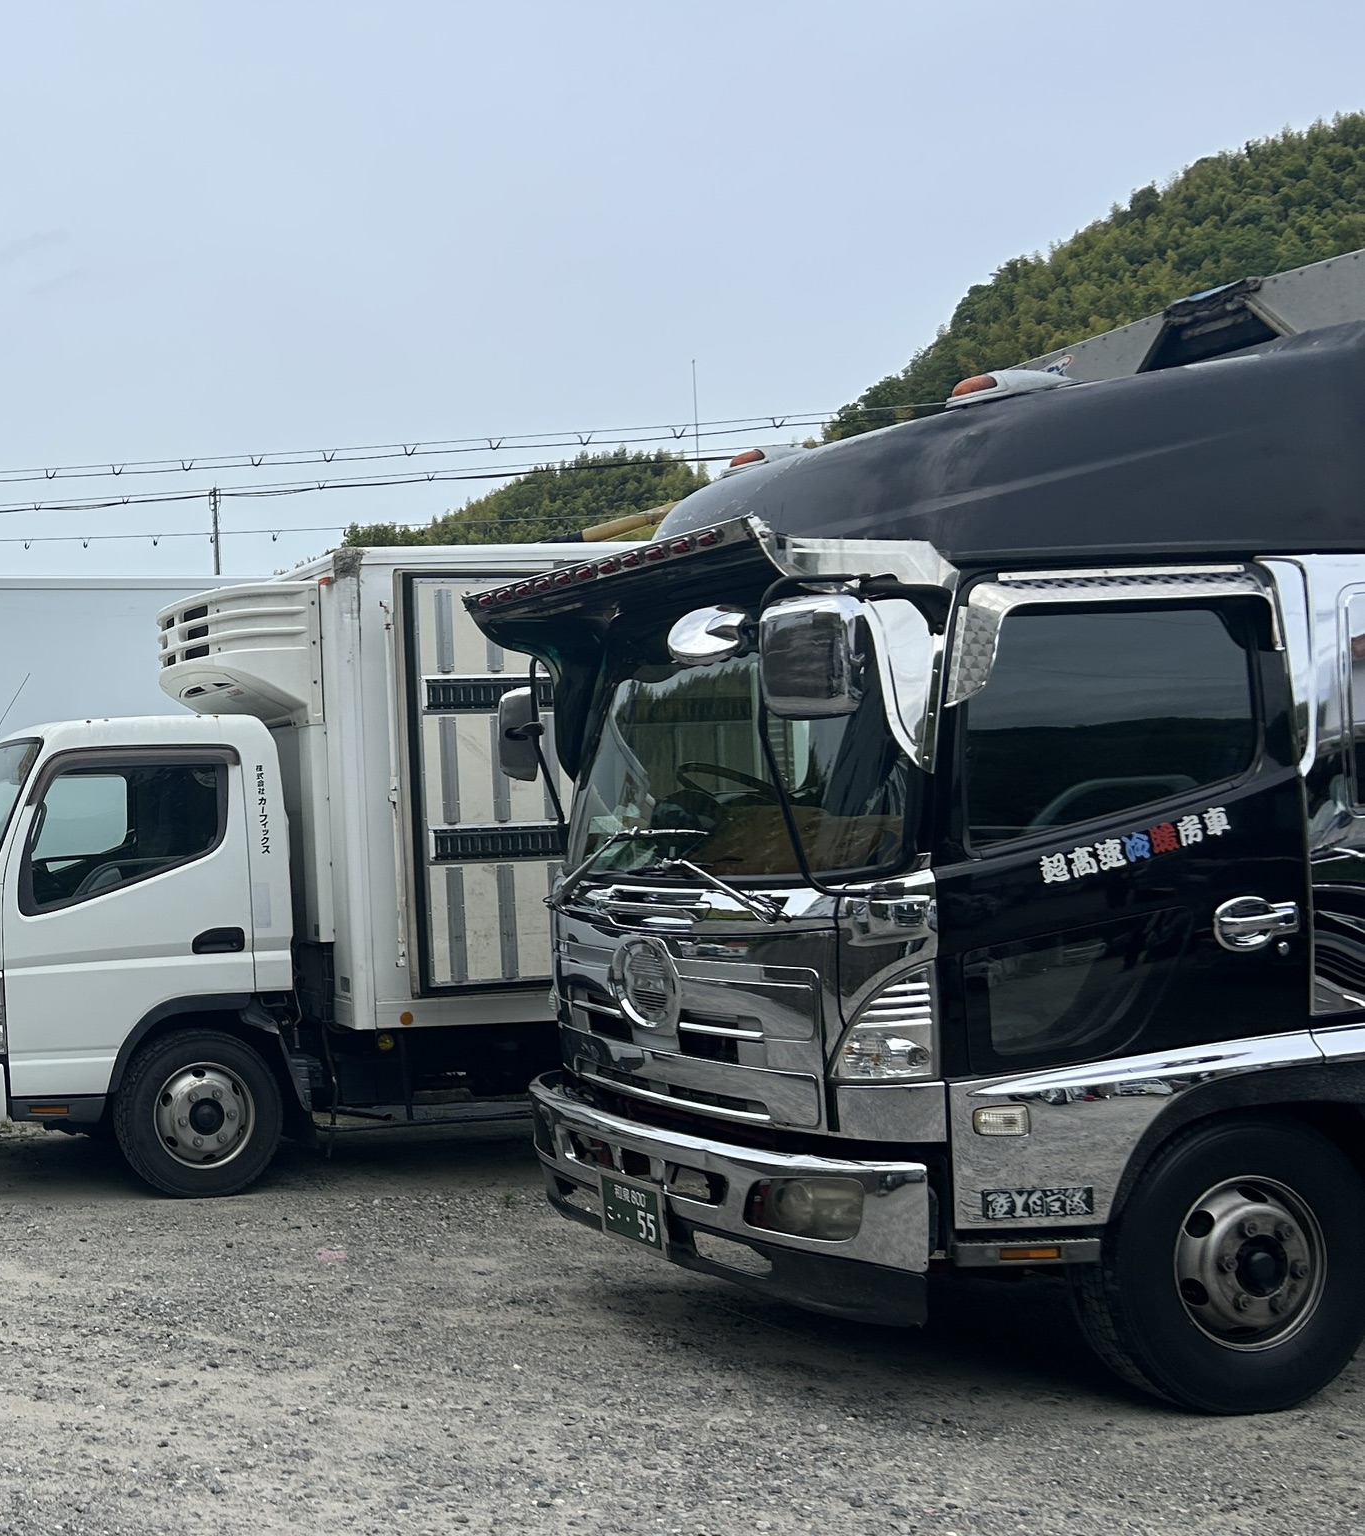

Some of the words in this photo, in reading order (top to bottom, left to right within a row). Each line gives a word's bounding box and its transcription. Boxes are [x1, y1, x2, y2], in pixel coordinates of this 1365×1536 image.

[1039, 806, 1232, 884] 超高速冷暖房車
